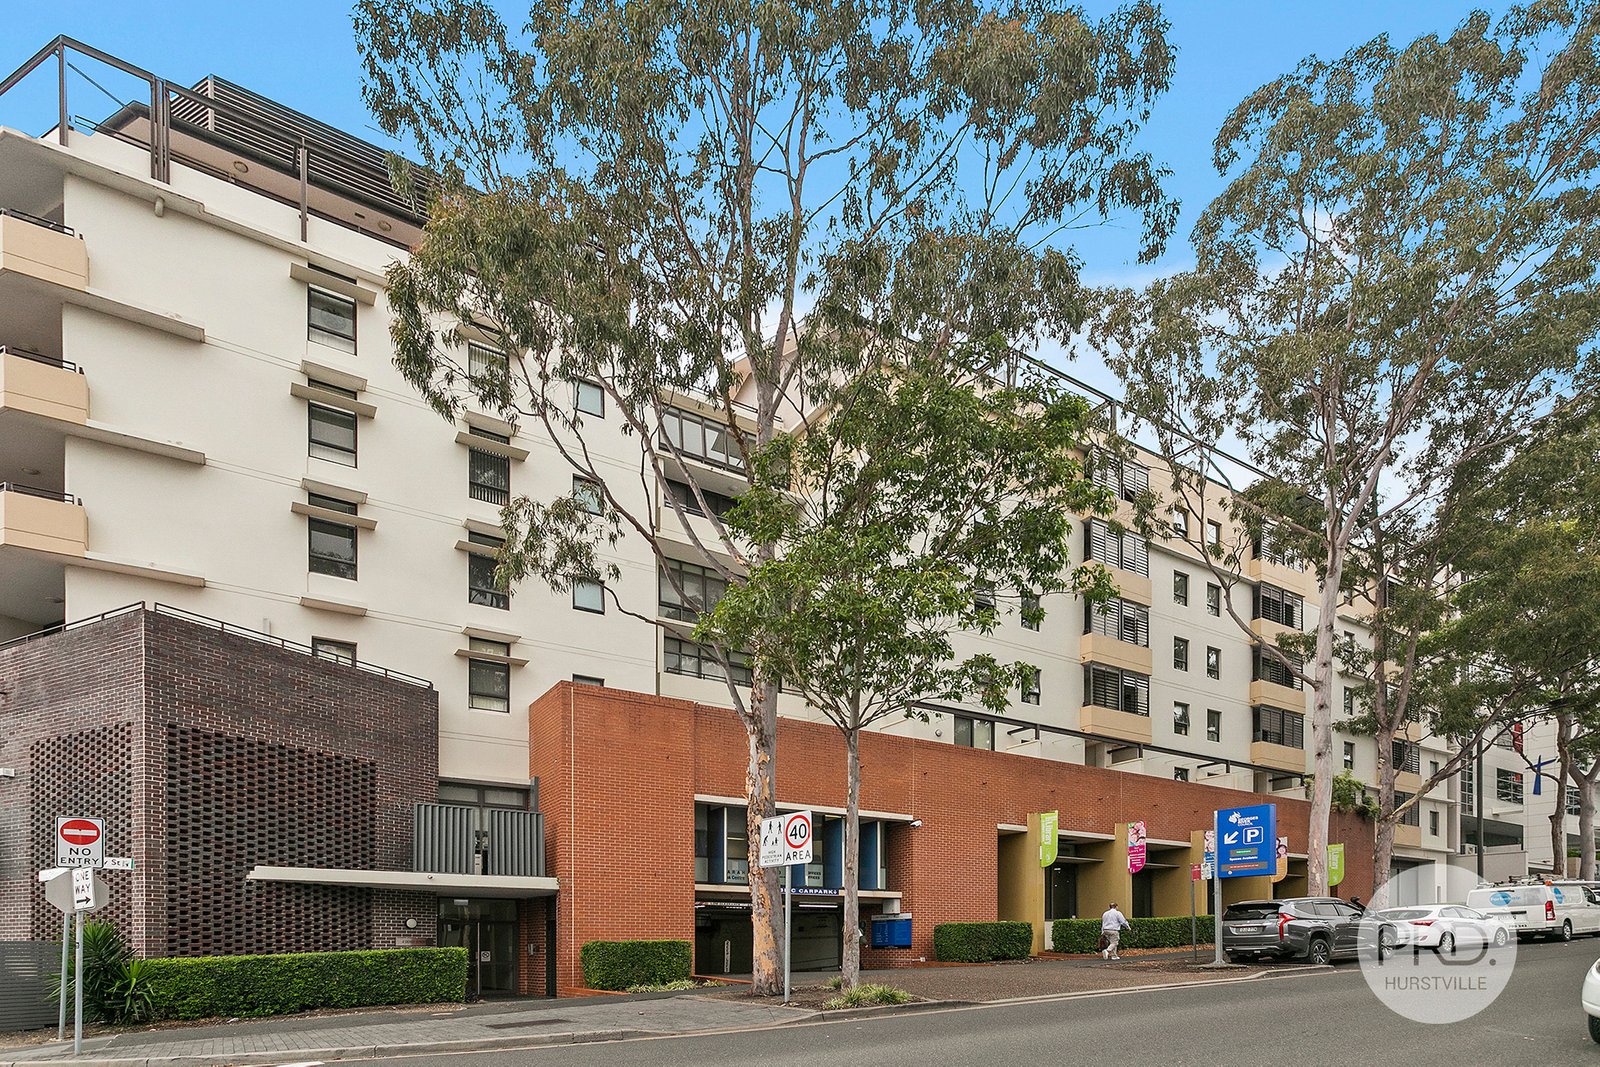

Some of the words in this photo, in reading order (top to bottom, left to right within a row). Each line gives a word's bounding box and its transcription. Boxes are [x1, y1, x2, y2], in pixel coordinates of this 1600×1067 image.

[790, 824, 807, 839] 40
[1246, 829, 1259, 842] P
[69, 848, 91, 856] NO
[786, 850, 811, 861] AREA
[60, 857, 99, 865] ENTRY
[75, 871, 89, 882] ONE
[75, 884, 90, 895] WAY
